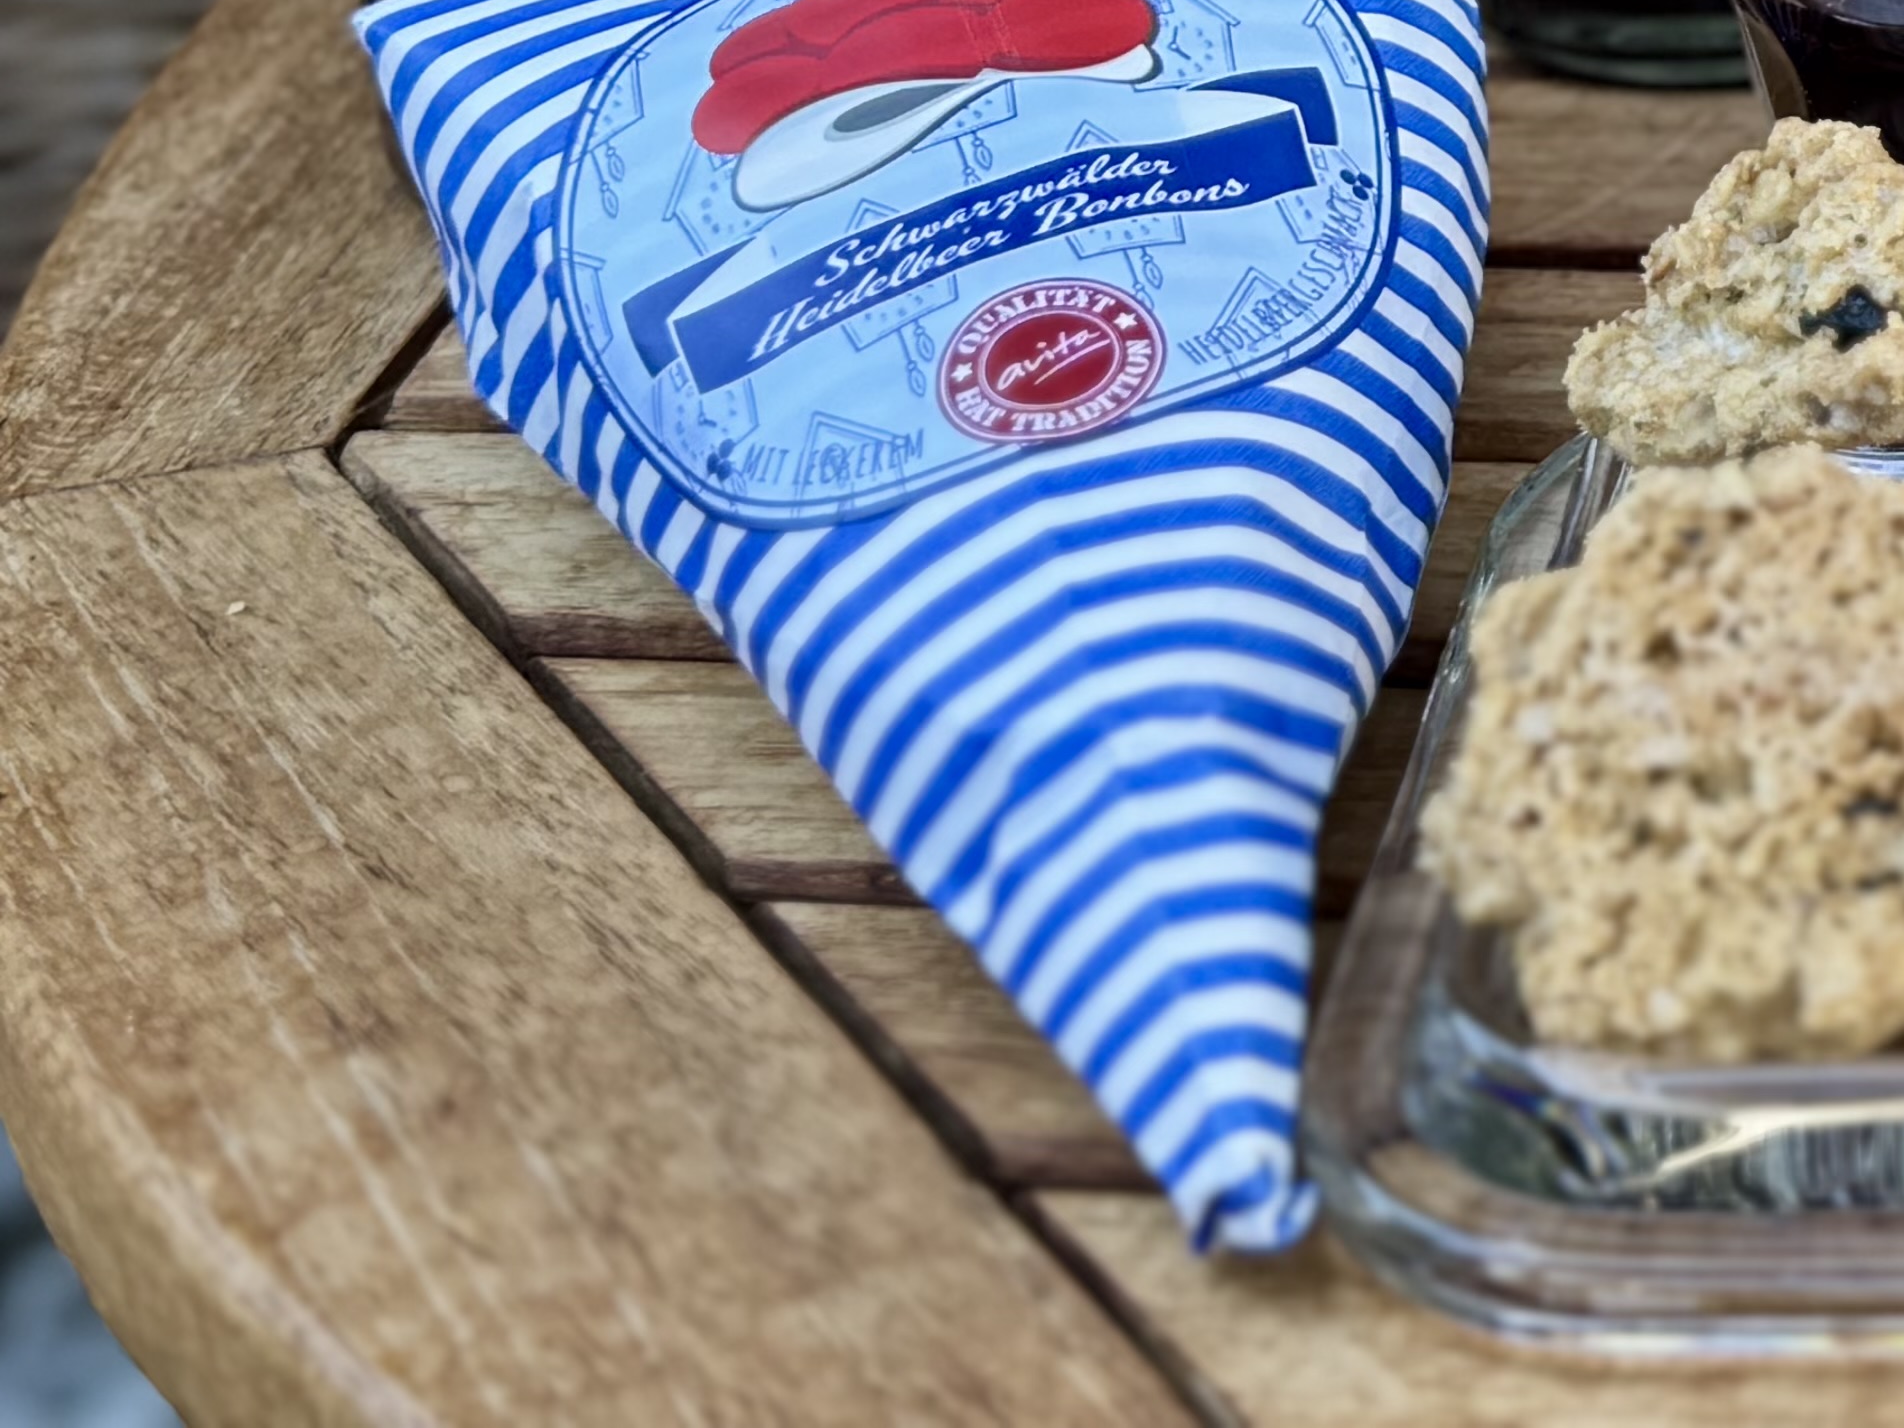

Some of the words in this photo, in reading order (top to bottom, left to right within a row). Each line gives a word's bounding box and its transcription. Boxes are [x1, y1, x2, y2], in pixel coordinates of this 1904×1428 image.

[813, 151, 1178, 290] Schwarzwälder
[746, 228, 1012, 363] Heidelbeer
[1032, 176, 1251, 237] Bonbons
[957, 286, 1117, 355] QUALITÄT
[1010, 339, 1152, 432] TRADITION
[742, 443, 790, 485] MIT
